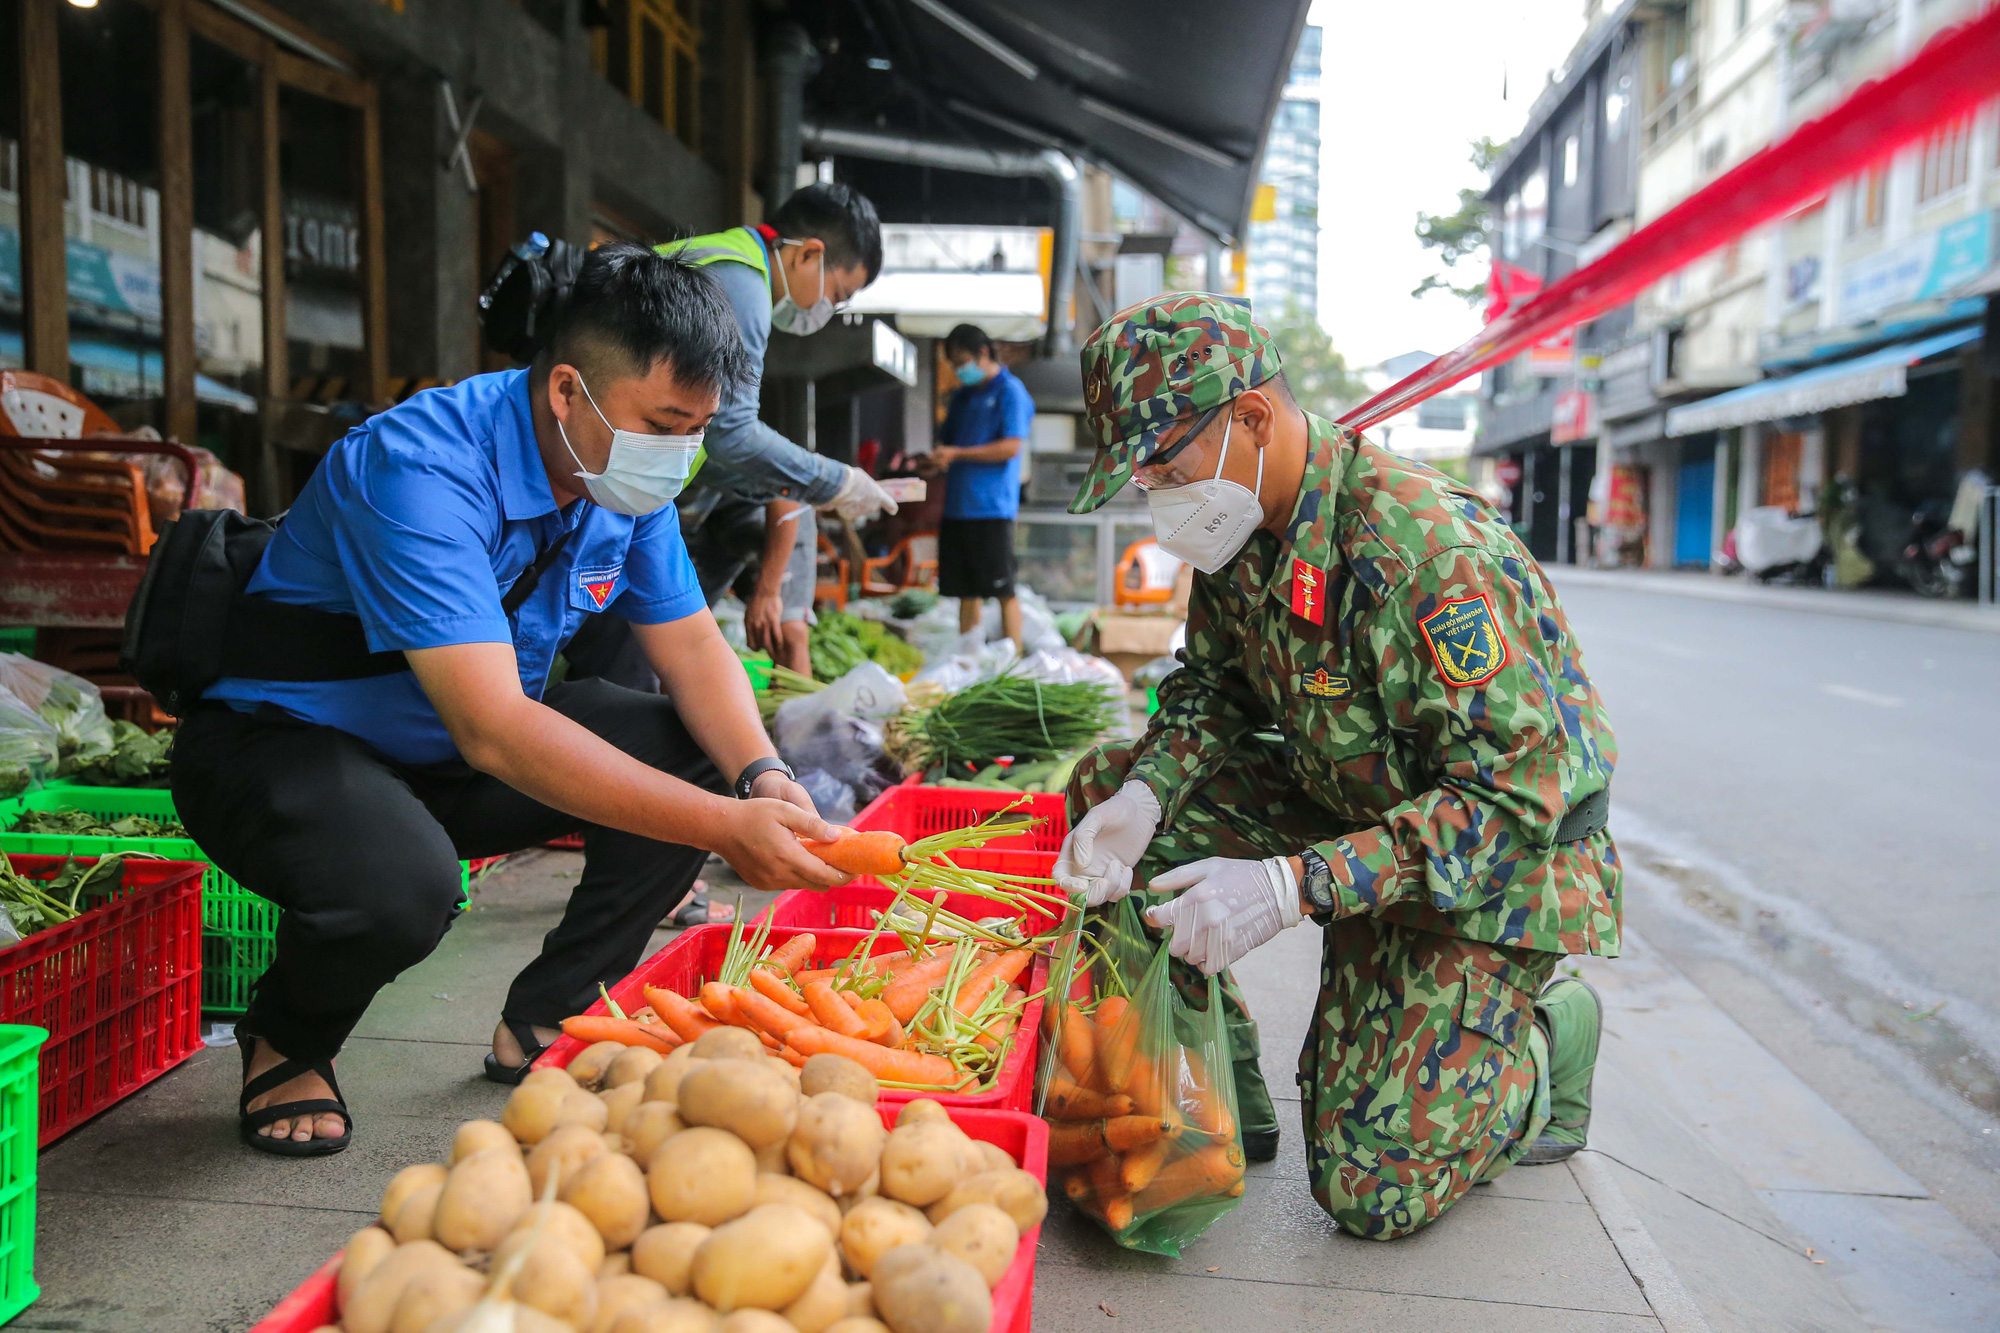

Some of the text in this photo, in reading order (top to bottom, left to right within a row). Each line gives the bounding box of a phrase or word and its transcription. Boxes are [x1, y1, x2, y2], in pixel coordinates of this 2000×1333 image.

[1430, 607, 1483, 634] QUÂN ĐỘI NHÂN DÂN
[1446, 621, 1475, 637] VIỆT NAM
